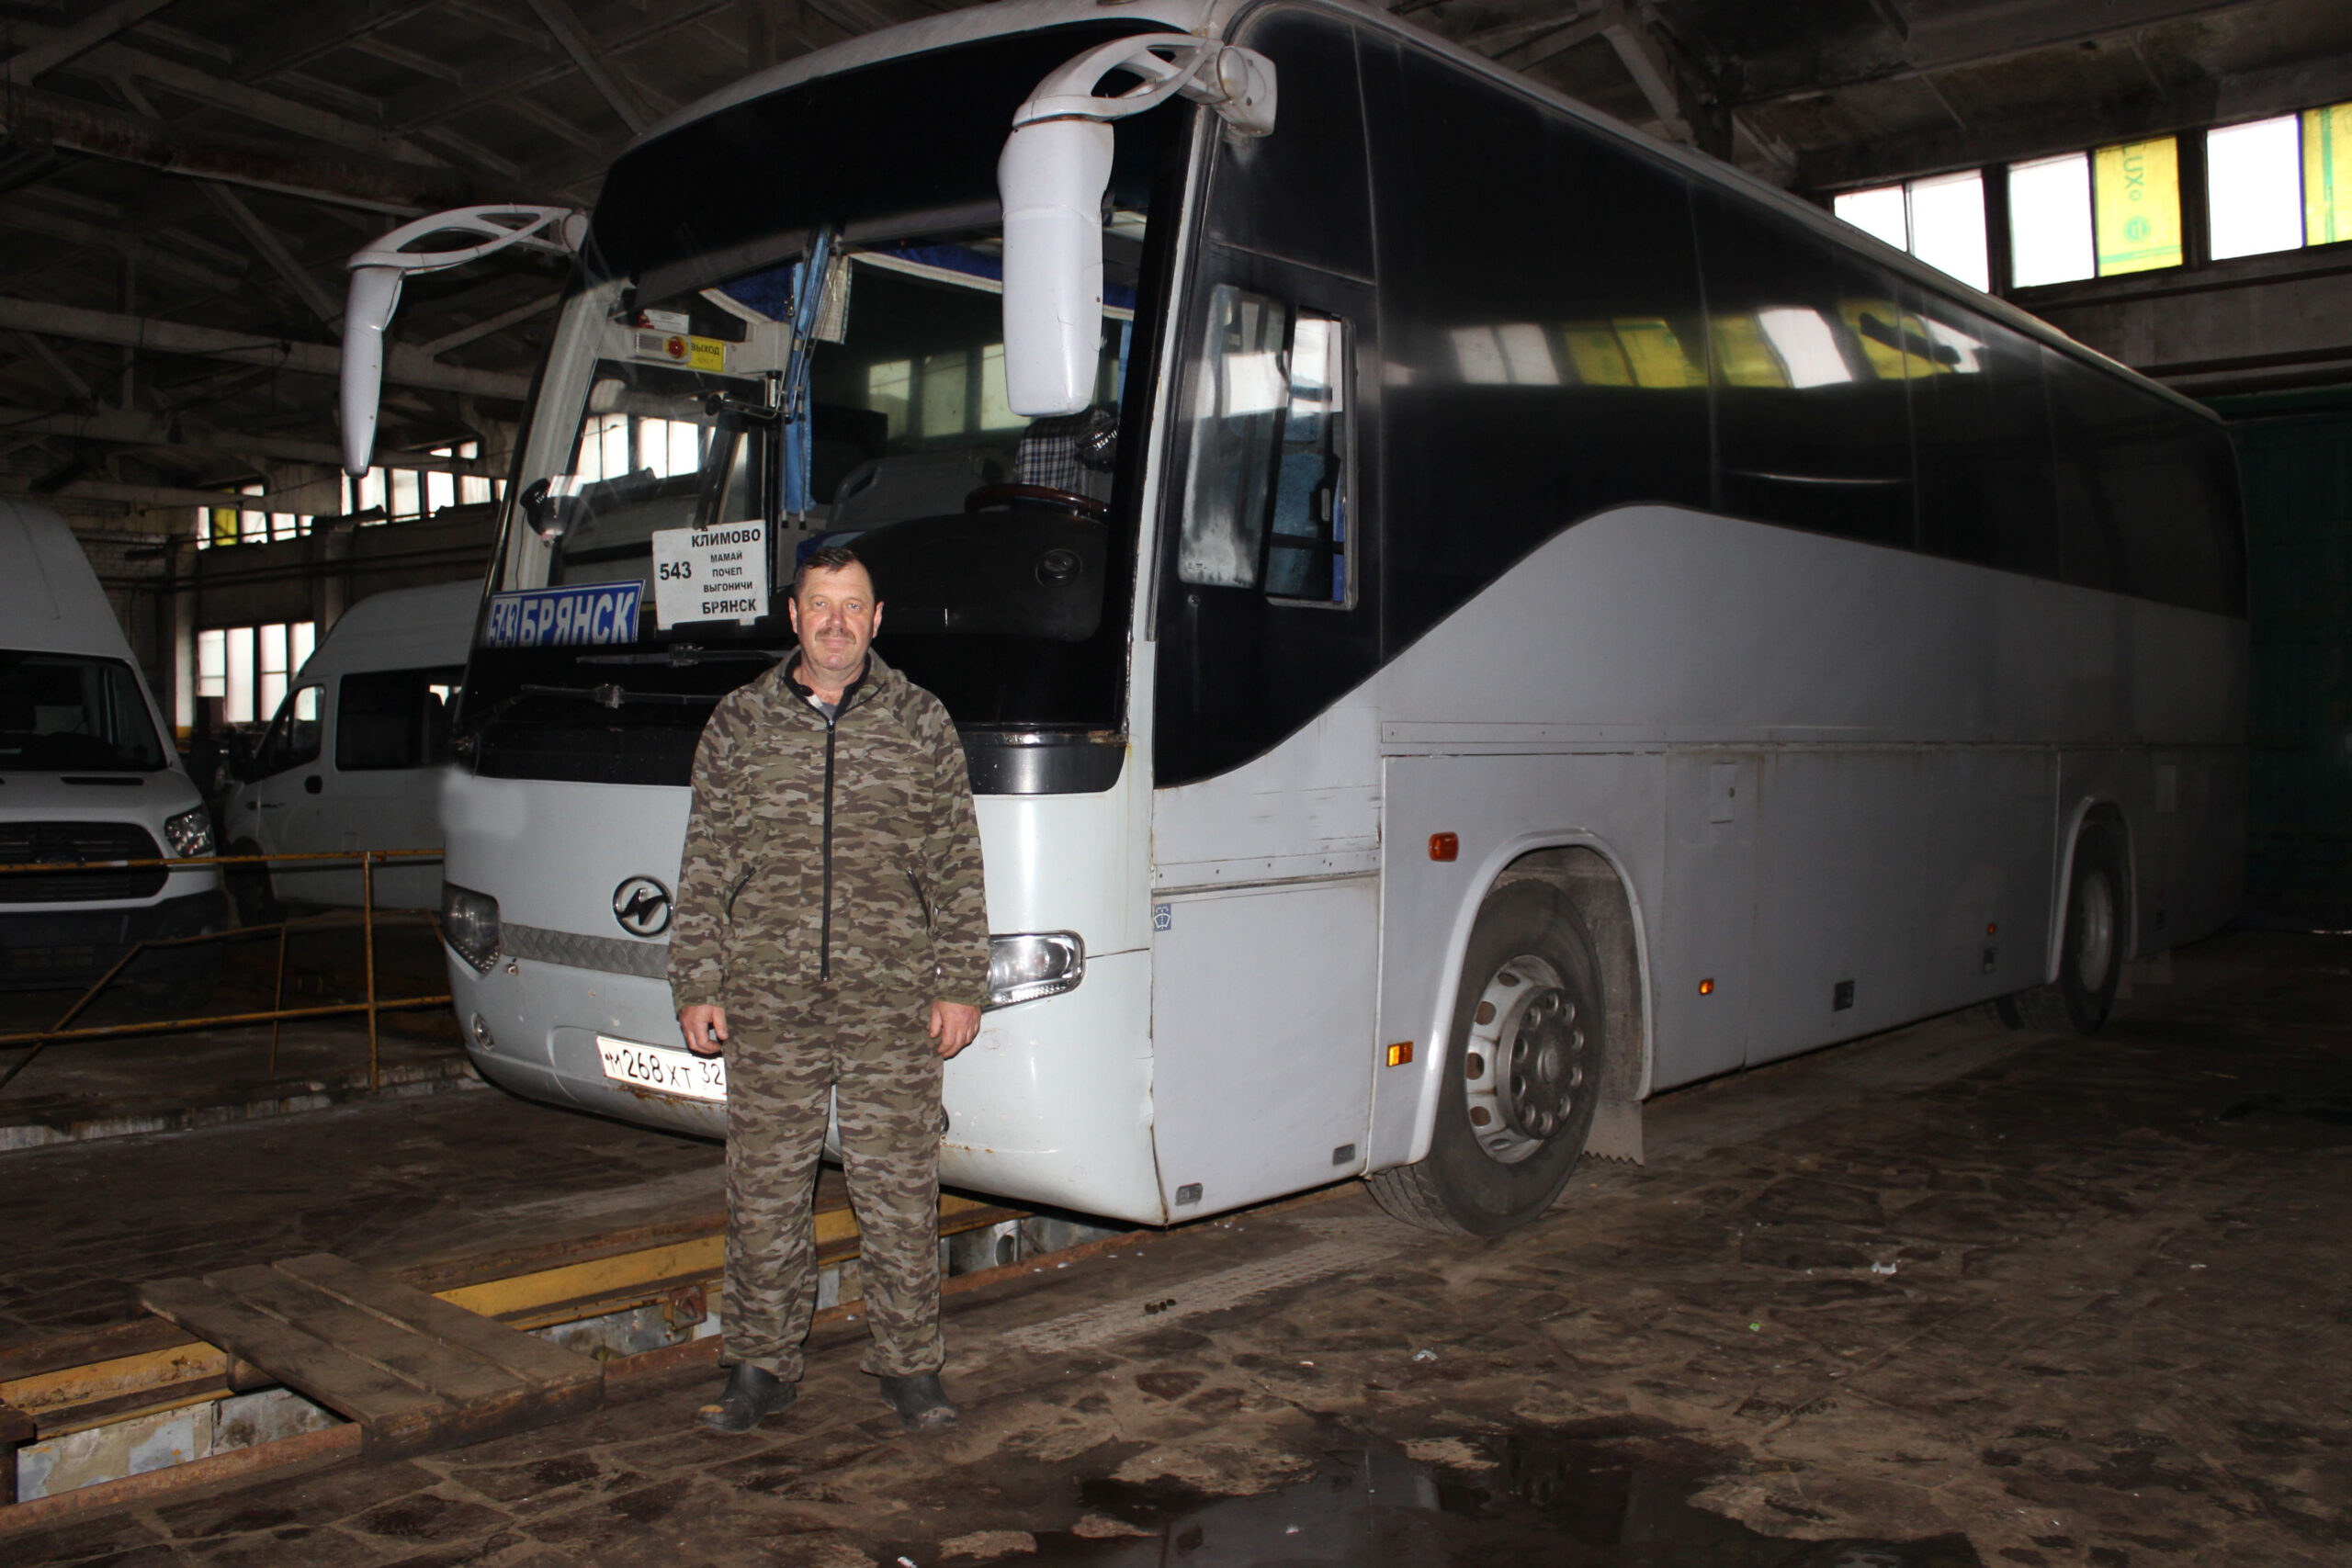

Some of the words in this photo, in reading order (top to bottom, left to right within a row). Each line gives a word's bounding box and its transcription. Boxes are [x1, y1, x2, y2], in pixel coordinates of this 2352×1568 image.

[691, 343, 720, 355] ВЫХОД
[691, 528, 761, 547] КЛИМОВО
[710, 550, 742, 563] МАМАЙ
[660, 560, 692, 581] 543
[712, 567, 742, 578] ПОЧЕП
[703, 581, 752, 593] ВЫГОНИЧИ
[702, 598, 757, 615] БРЯНСК
[489, 599, 519, 646] 543
[519, 592, 636, 646] БРЯНСК
[697, 1061, 723, 1086] 32
